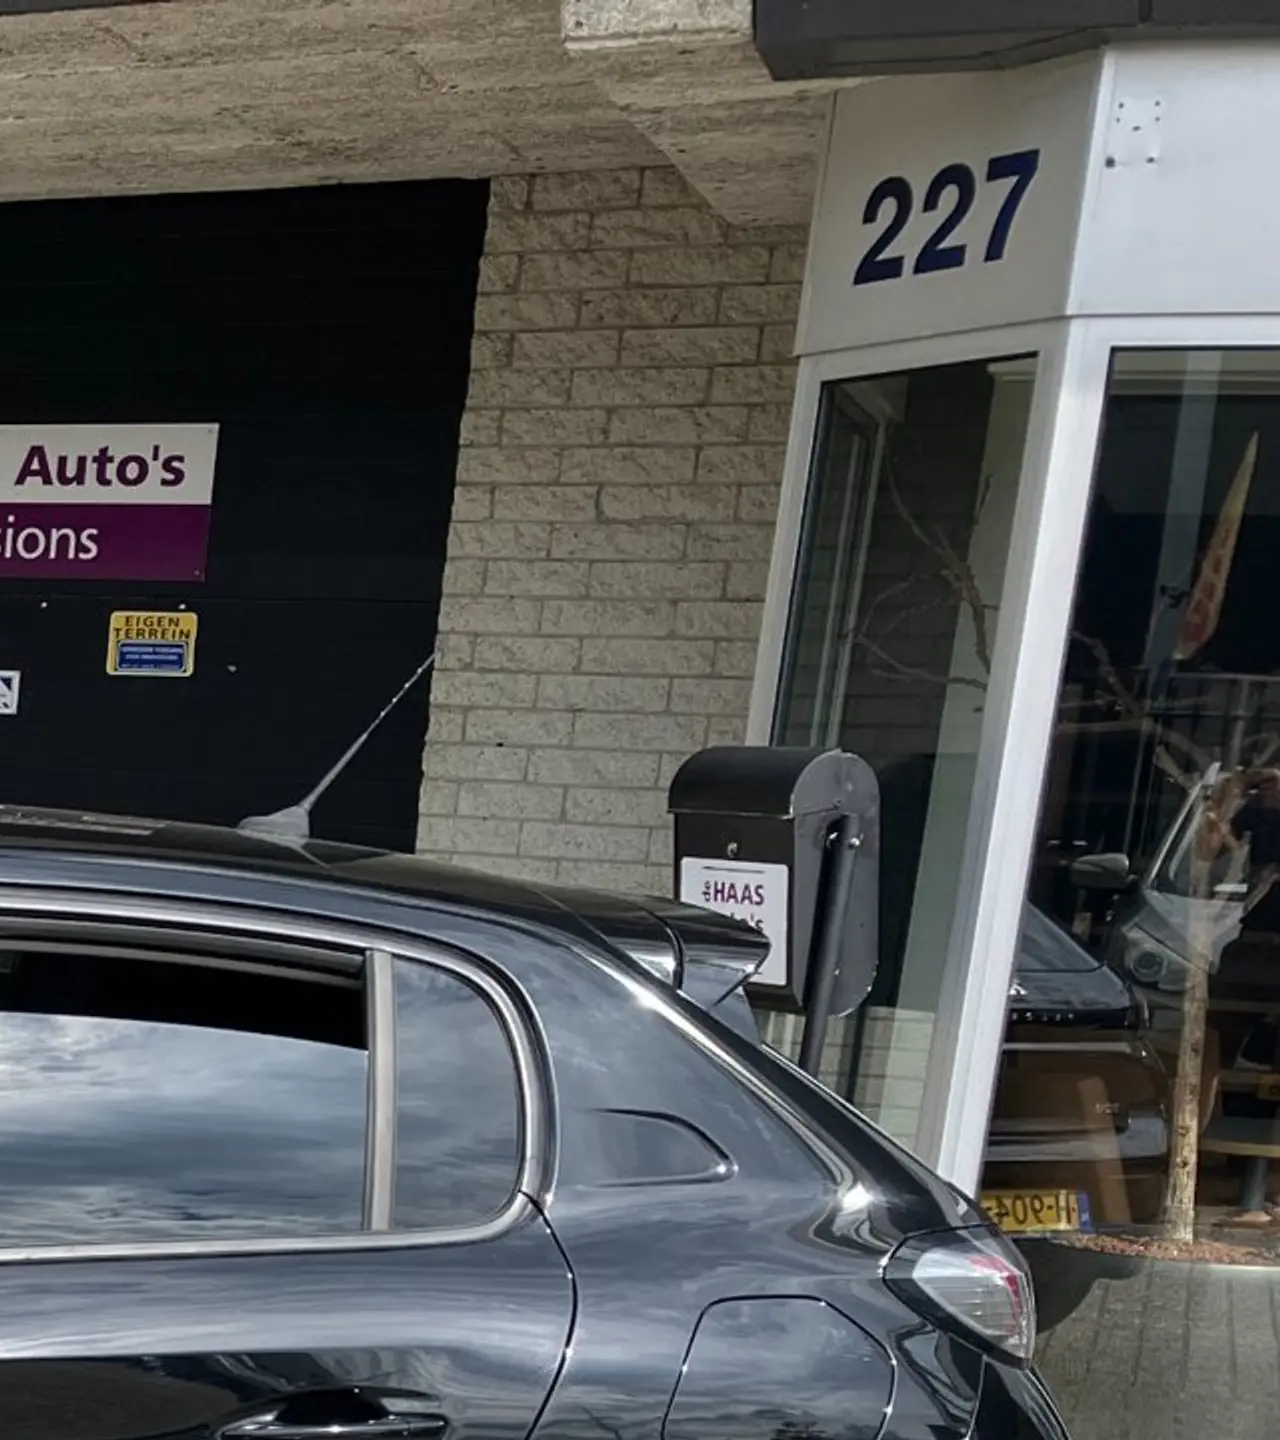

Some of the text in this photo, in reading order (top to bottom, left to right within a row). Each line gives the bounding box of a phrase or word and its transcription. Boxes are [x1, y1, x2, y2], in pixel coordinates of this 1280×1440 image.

[852, 148, 1040, 286] 227
[14, 443, 187, 487] Auto's
[113, 628, 192, 640] TERREIN
[124, 615, 180, 627] EIGEN
[713, 880, 765, 906] HAAS
